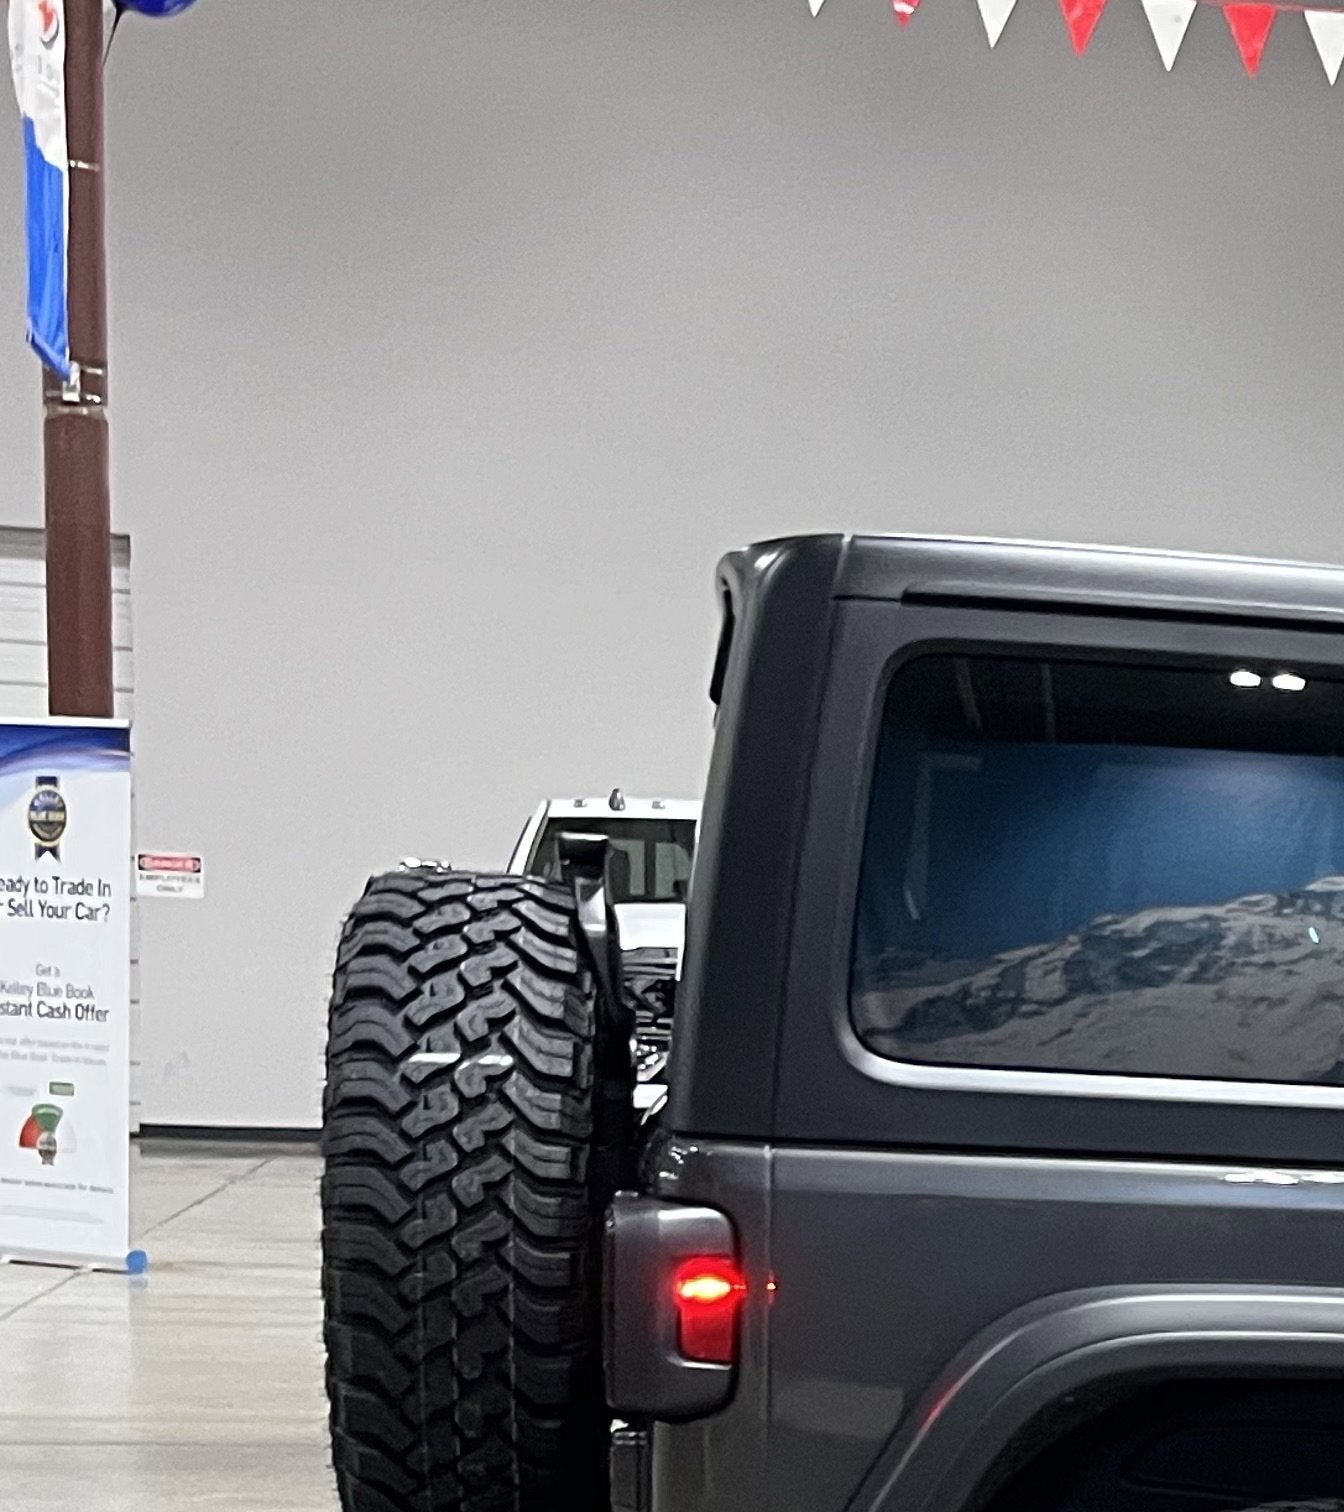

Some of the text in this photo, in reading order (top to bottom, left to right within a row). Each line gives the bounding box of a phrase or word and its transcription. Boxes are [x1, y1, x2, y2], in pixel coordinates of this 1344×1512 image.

[34, 876, 49, 894] to
[52, 875, 94, 897] Trade
[97, 877, 112, 897] In
[7, 898, 111, 923] Sell Your Car?
[66, 982, 95, 1000] Book
[37, 999, 72, 1019] Cash
[75, 1002, 110, 1023] Offer
